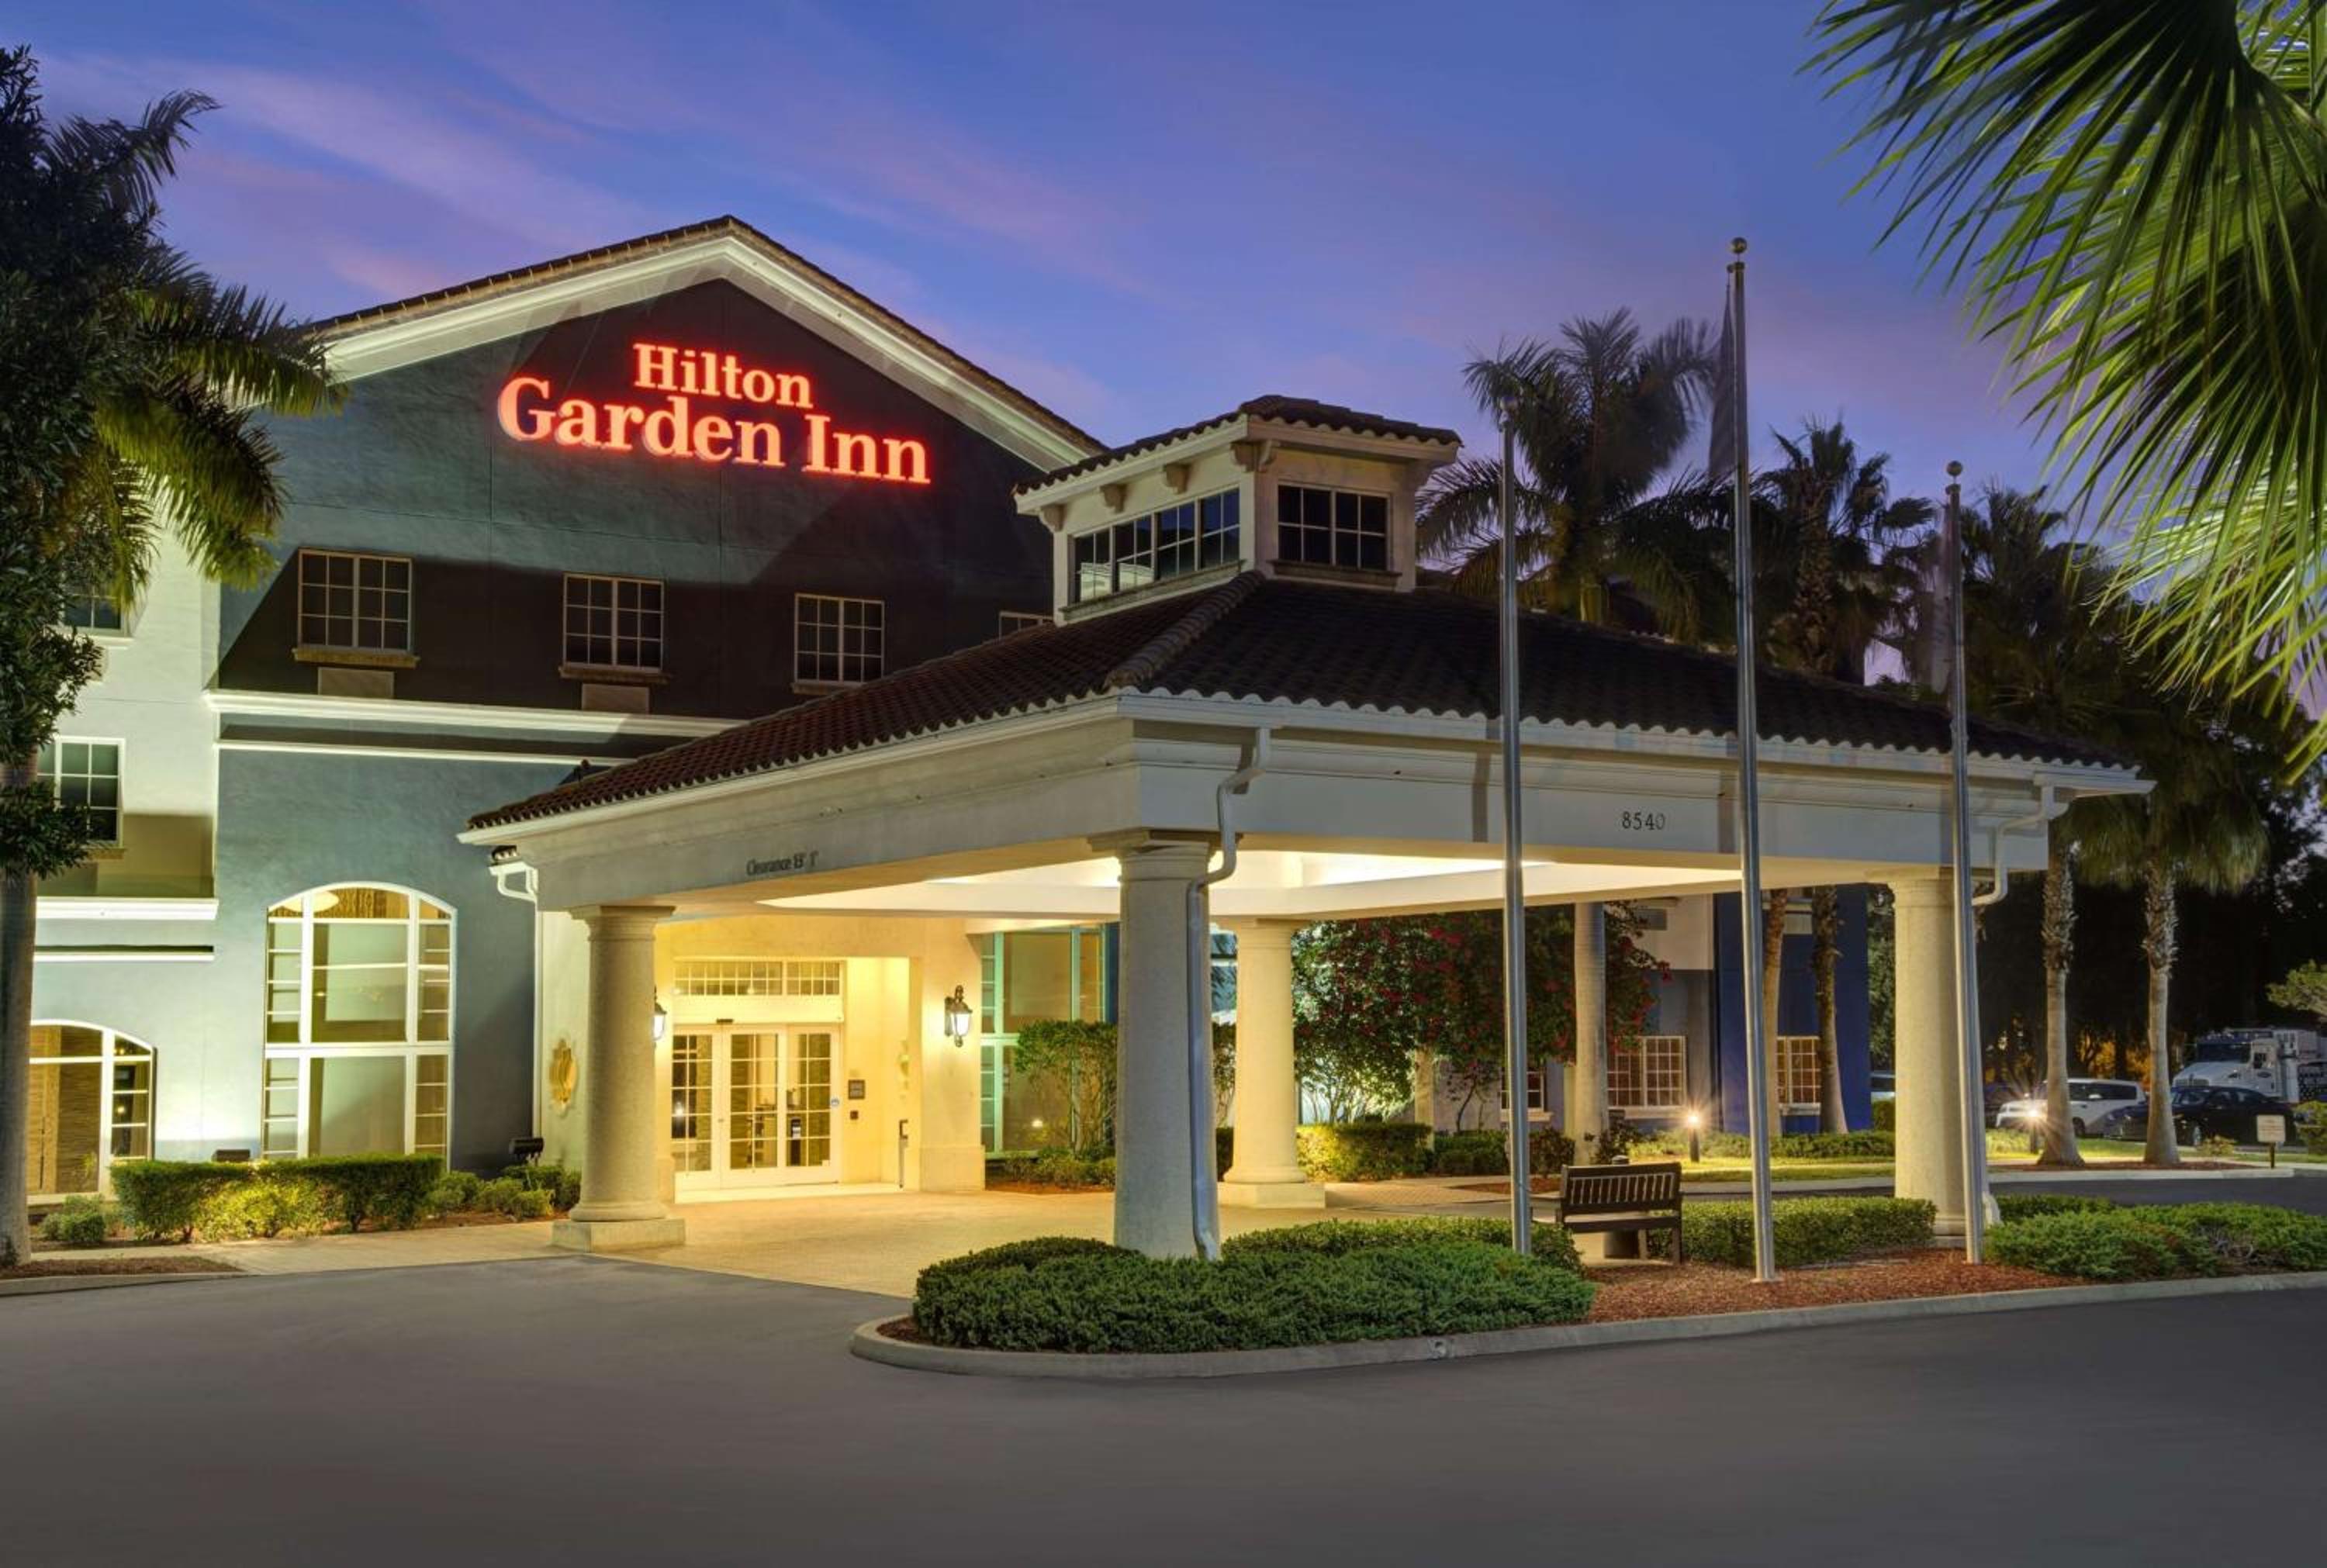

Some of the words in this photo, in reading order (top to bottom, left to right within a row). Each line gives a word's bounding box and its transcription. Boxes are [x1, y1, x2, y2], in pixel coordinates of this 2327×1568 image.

[632, 343, 813, 408] Hilton
[498, 376, 786, 467] Garden
[800, 413, 930, 484] Inn
[1622, 811, 1665, 831] 8540
